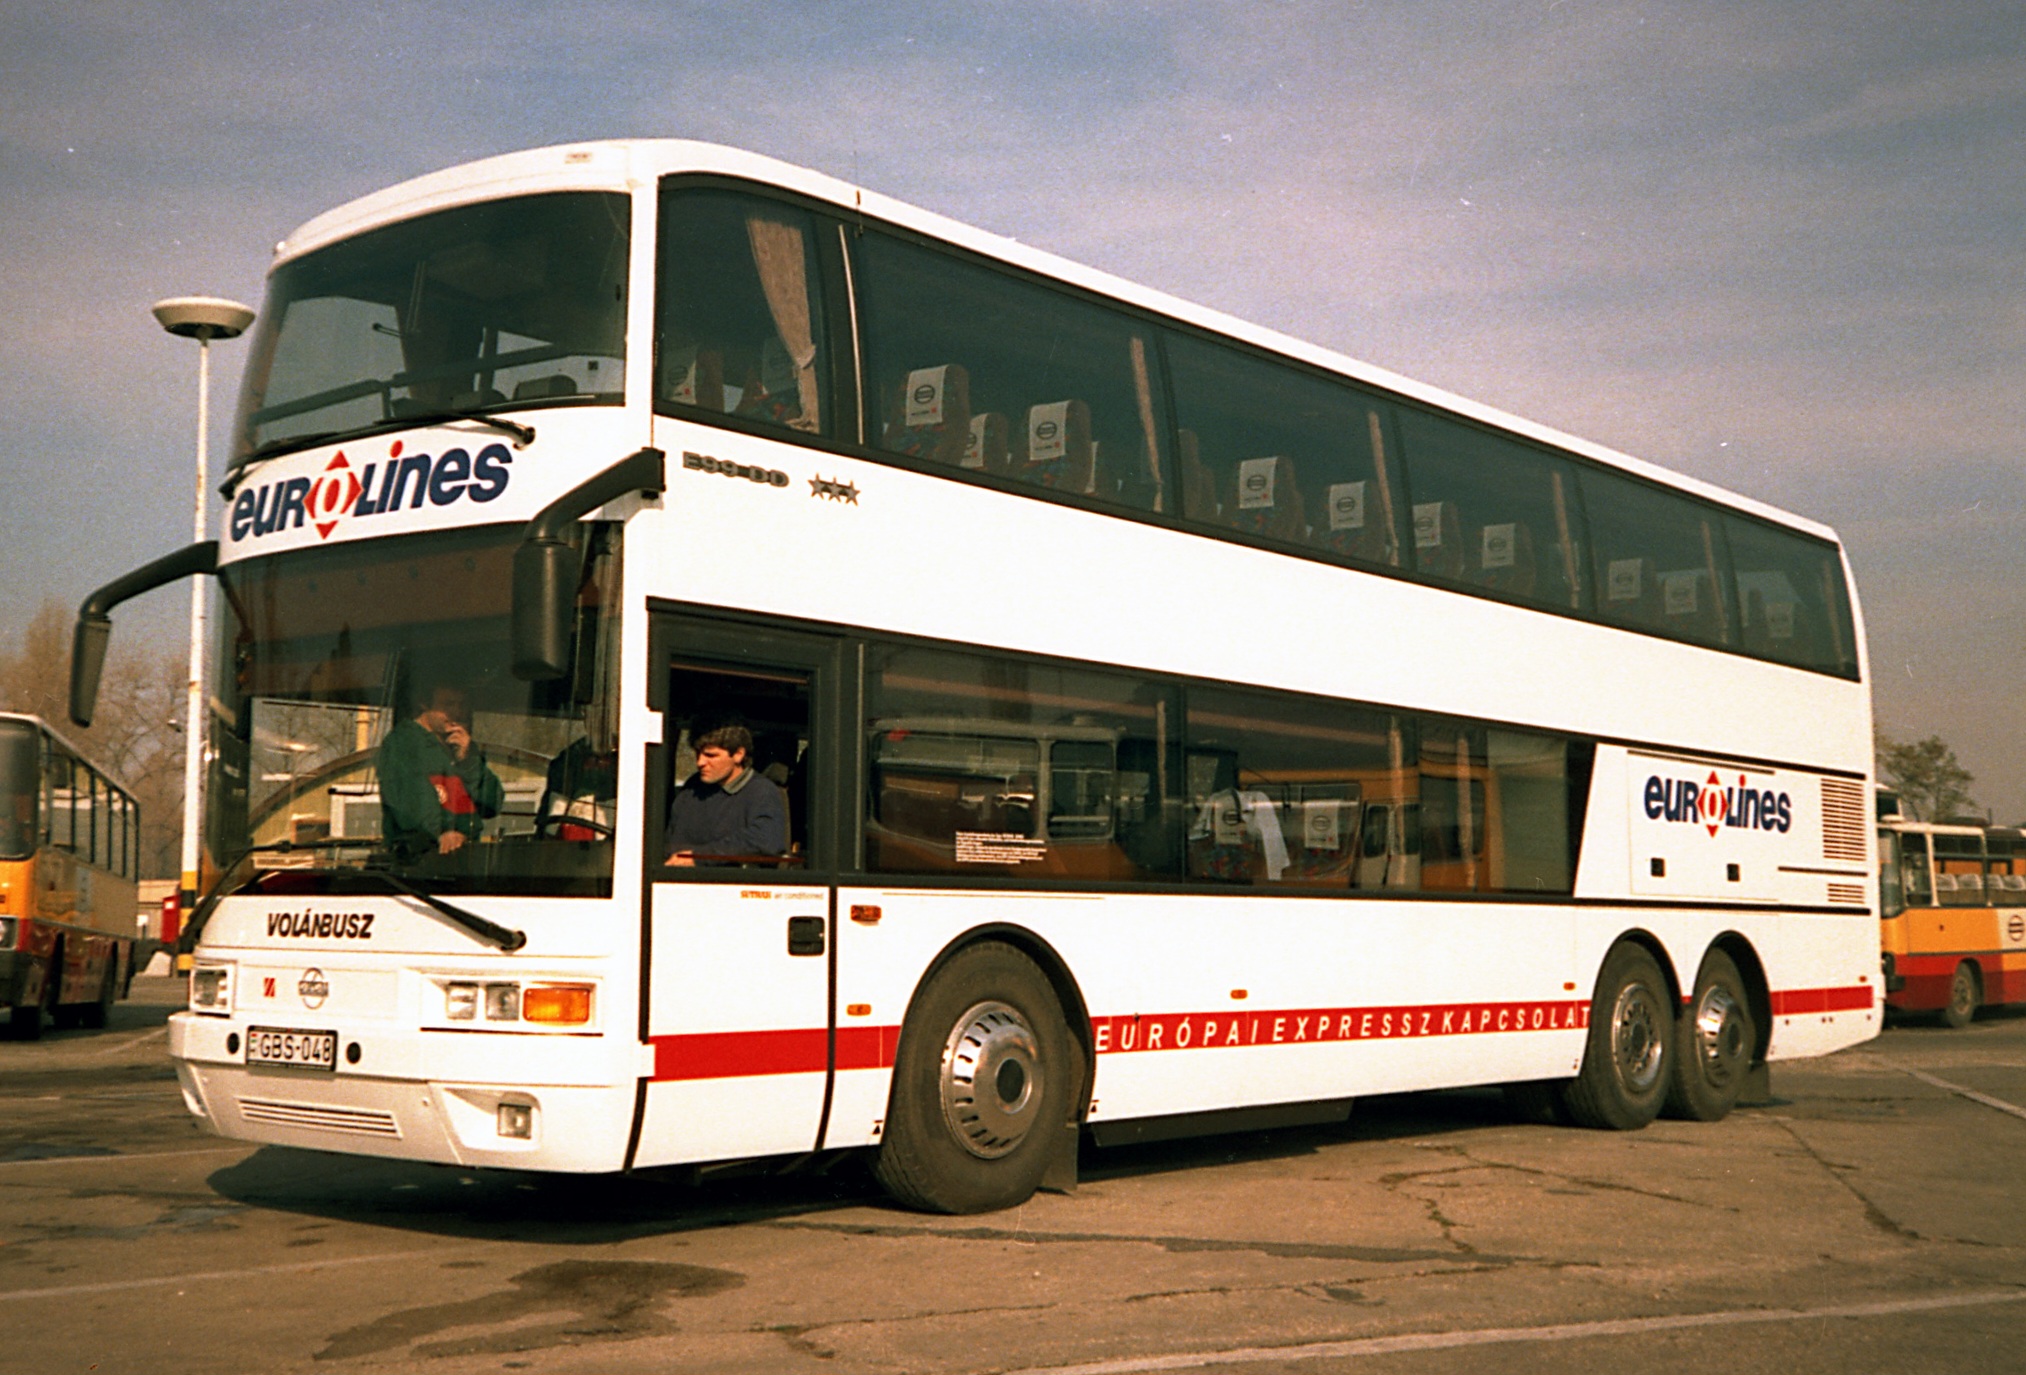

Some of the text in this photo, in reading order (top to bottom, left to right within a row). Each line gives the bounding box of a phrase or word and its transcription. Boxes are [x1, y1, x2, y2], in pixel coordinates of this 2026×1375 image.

[748, 465, 790, 488] DD
[267, 908, 375, 940] VOLÁNBUSZ
[1095, 1016, 1259, 1051] EURÓPAI
[1272, 1012, 1431, 1042] EXPRESSZ
[260, 1033, 331, 1063] GBS-048
